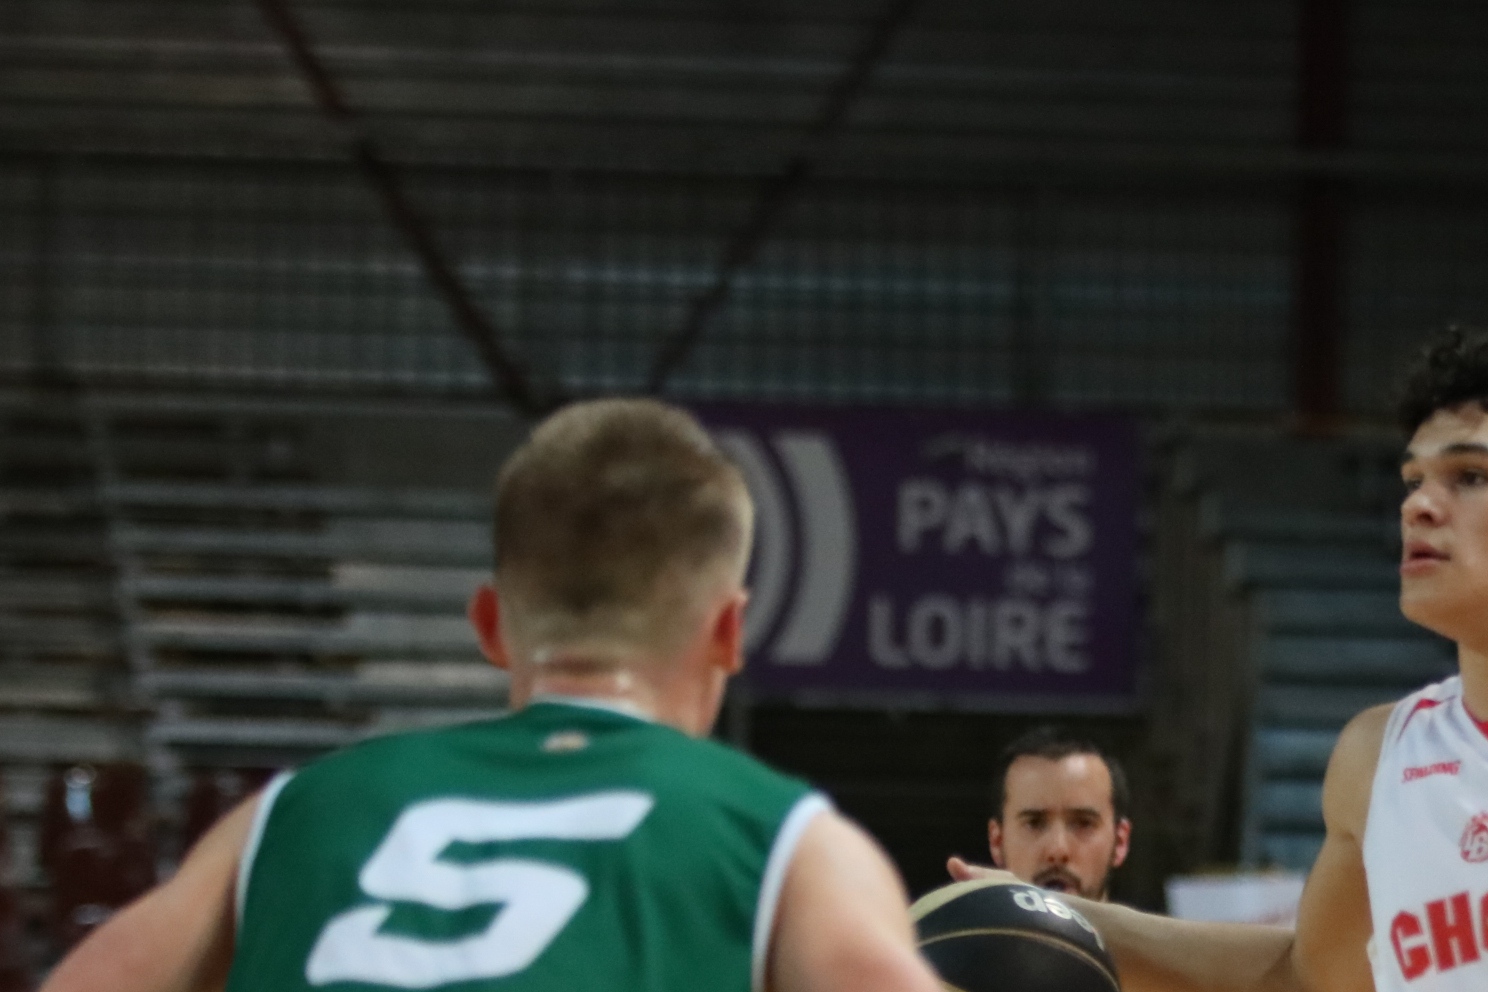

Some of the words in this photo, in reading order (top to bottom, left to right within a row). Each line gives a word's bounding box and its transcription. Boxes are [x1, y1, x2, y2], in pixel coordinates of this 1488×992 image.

[898, 478, 1094, 556] PAYS
[868, 596, 1092, 673] LOIRE
[306, 789, 655, 989] 5
